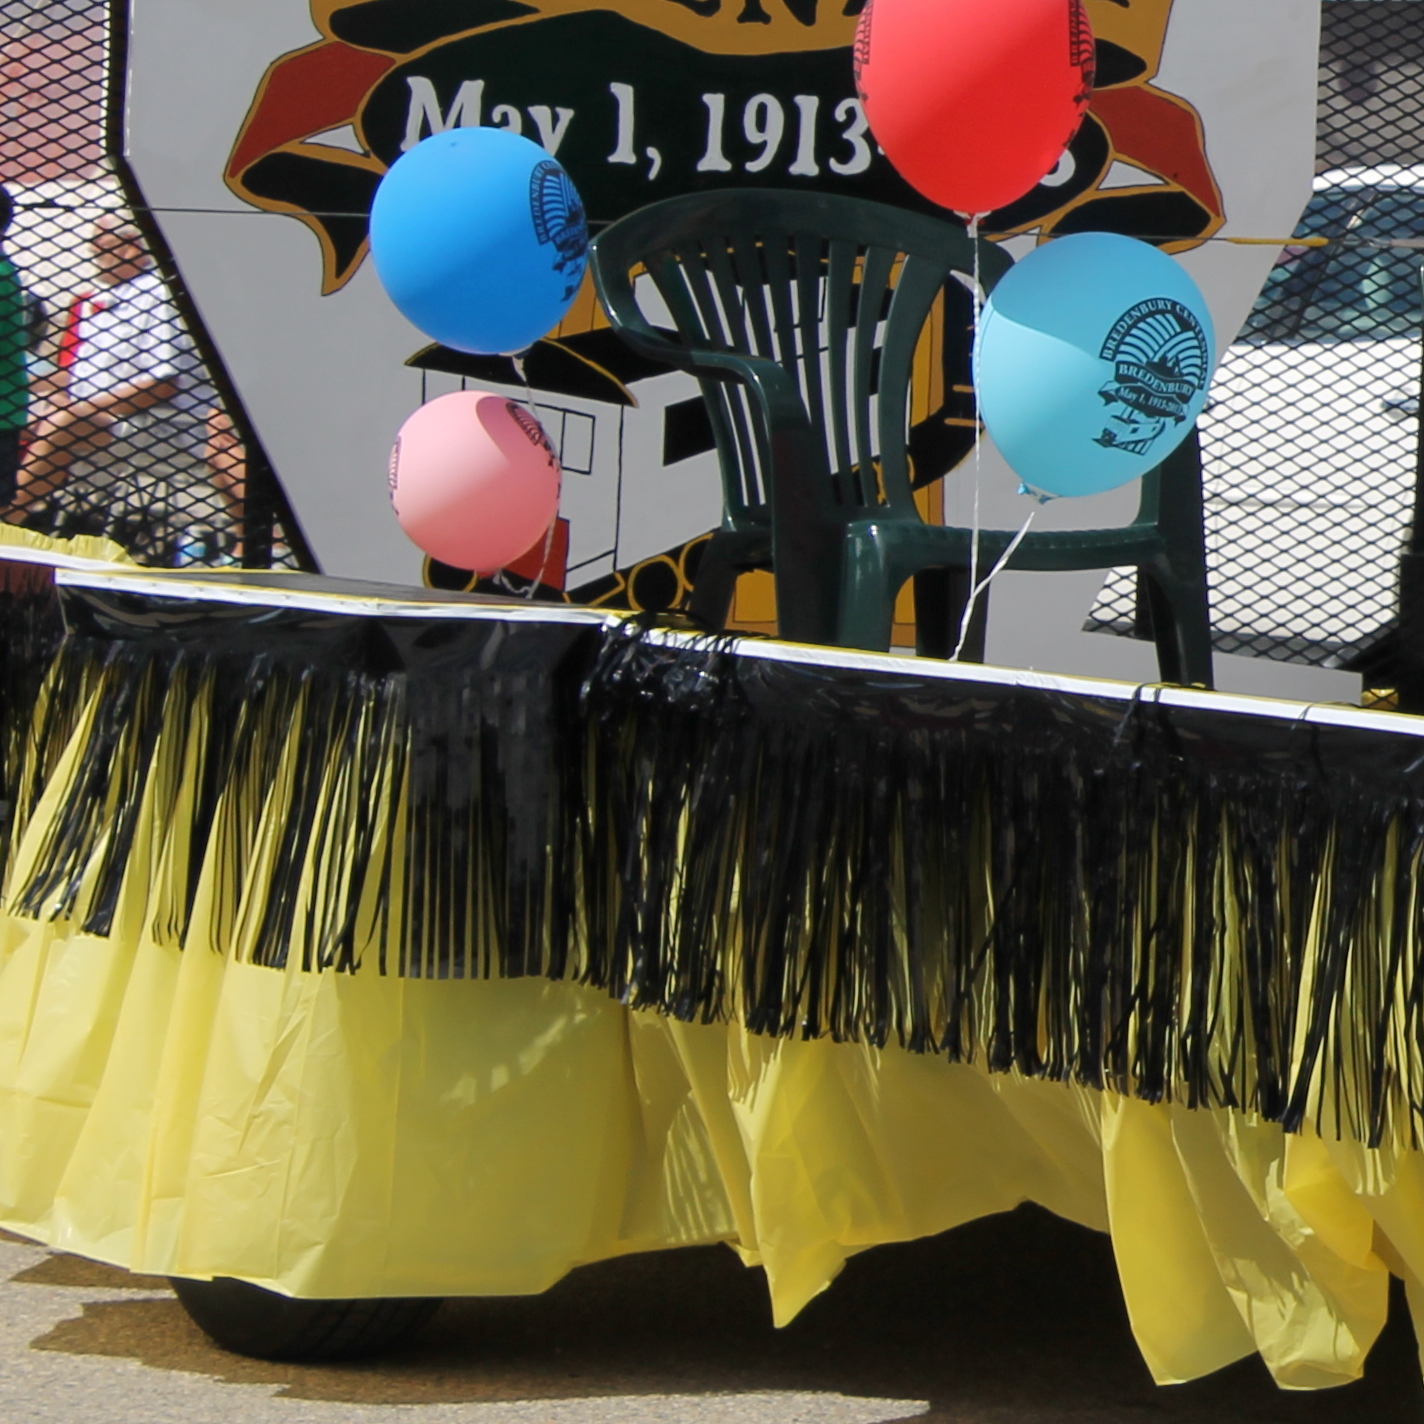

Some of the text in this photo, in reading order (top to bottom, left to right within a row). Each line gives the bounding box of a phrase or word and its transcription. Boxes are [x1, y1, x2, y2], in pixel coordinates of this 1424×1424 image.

[607, 82, 662, 180] 1,
[1102, 298, 1172, 360] BREDENBURY
[1118, 364, 1195, 397] BREDENBURY
